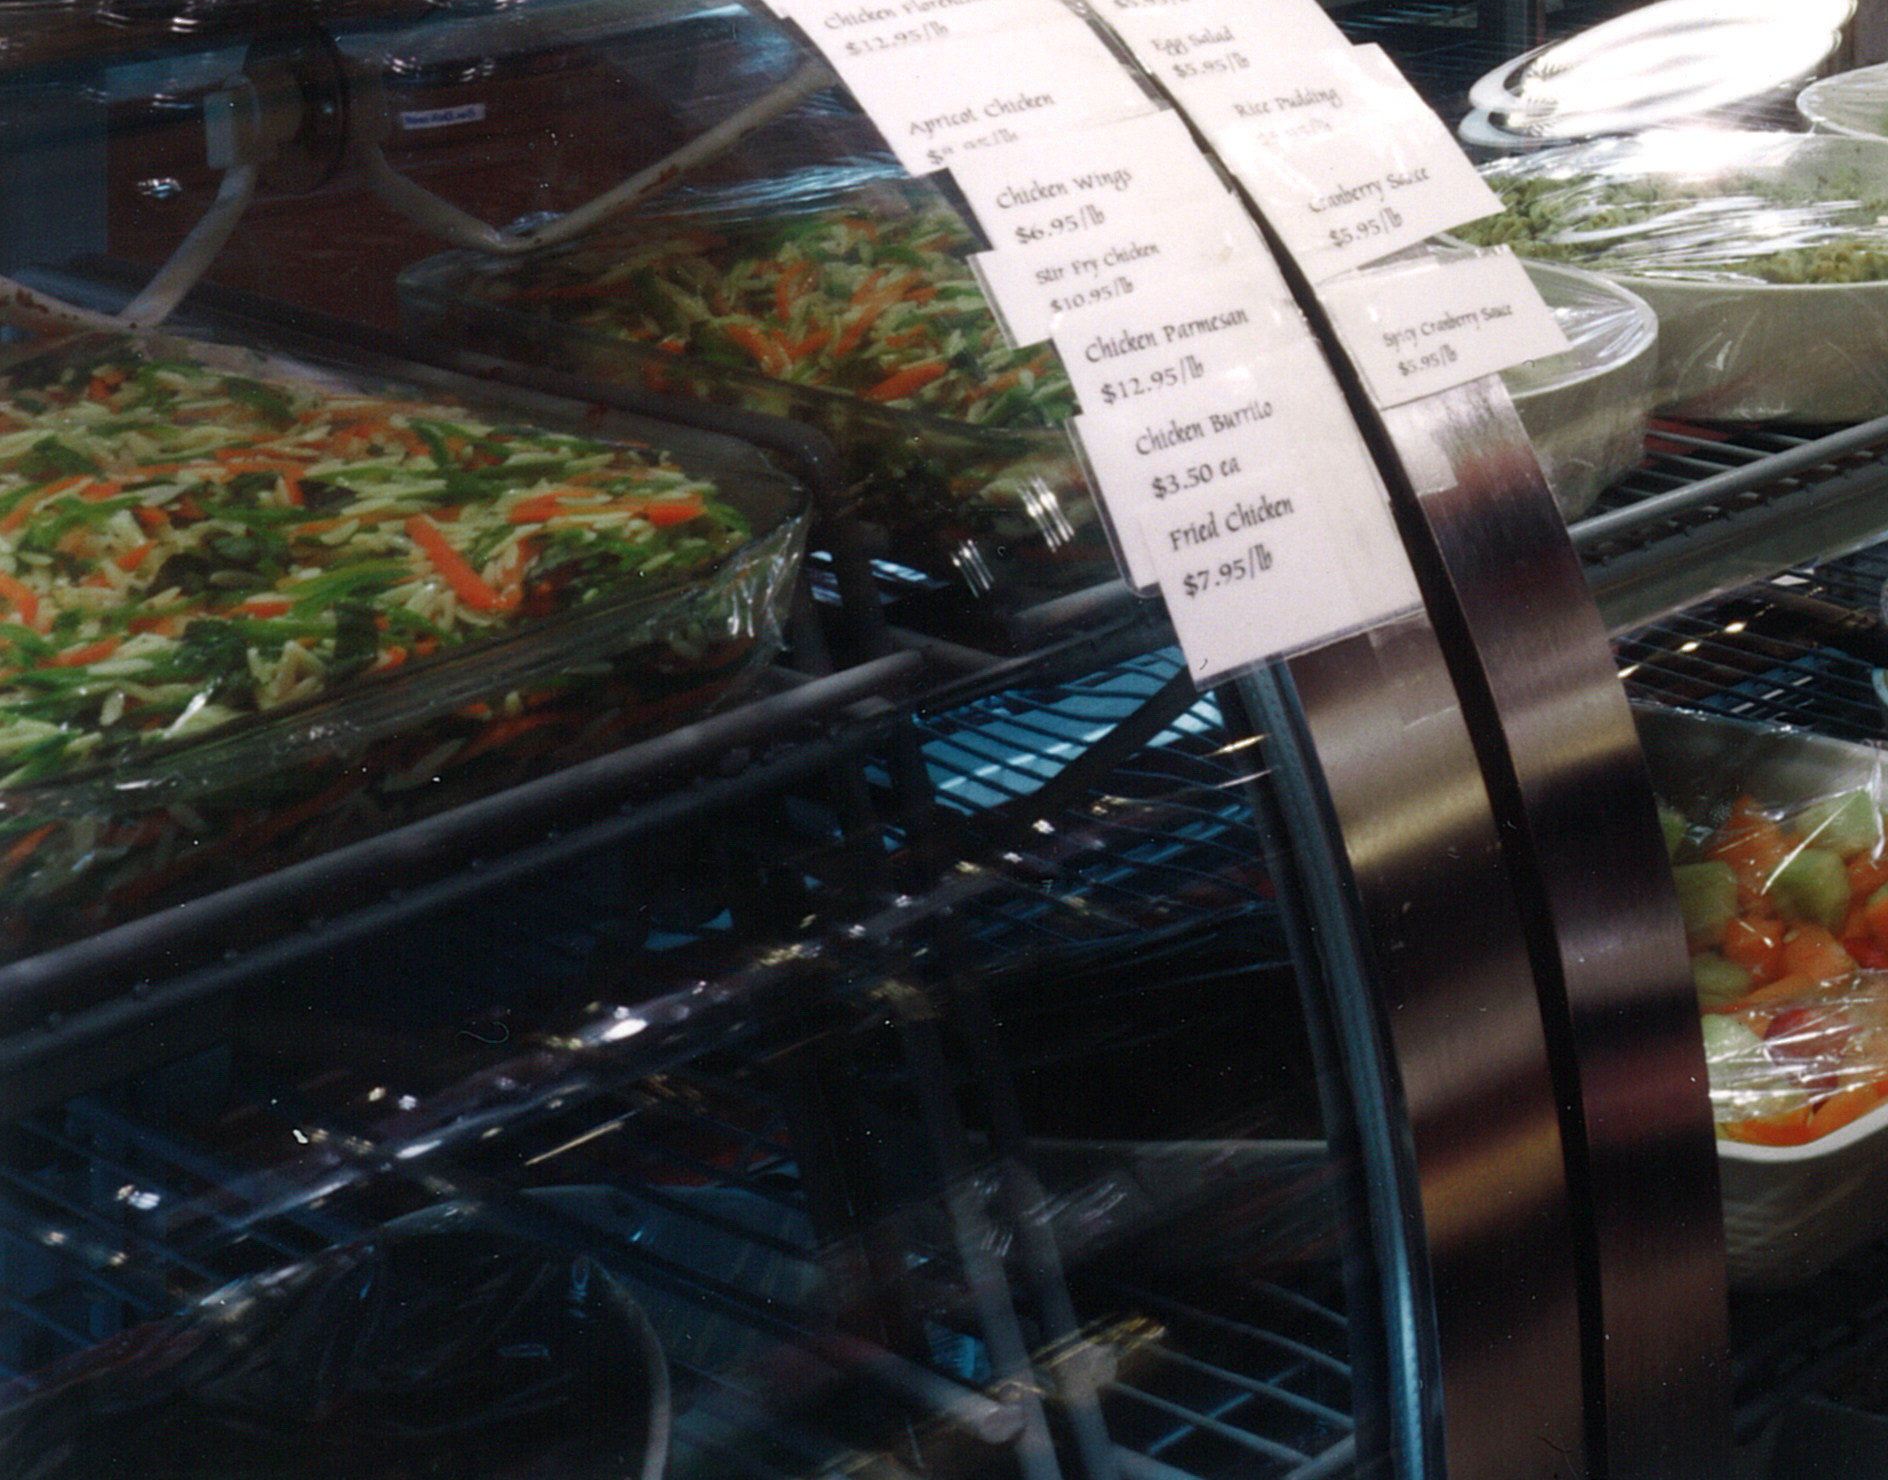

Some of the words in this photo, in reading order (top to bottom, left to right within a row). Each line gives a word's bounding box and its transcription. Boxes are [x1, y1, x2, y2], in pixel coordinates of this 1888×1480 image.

[823, 3, 897, 30] Chicken
[844, 20, 949, 56] $12.95/lb
[1150, 37, 1190, 57] Egg
[1187, 24, 1236, 46] Salad
[1172, 50, 1251, 80] $5.95/lb
[908, 106, 979, 140] Apricot
[983, 91, 1055, 119] Chicken
[1232, 99, 1272, 119] Rice
[1275, 84, 1343, 113] Pudding
[996, 180, 1069, 210] Chicken
[1073, 167, 1132, 192] Wings
[1307, 178, 1383, 214] Cranberry
[1014, 203, 1106, 245] $6.95/lb
[1327, 205, 1404, 249] $5.95/lb
[1035, 265, 1065, 286] Stir
[1071, 258, 1099, 279] Fry
[1103, 241, 1161, 268] Chicken
[1049, 275, 1134, 314] $10.95/lb
[1084, 327, 1158, 365] Chicken
[1162, 305, 1250, 344] Parmesan
[1099, 353, 1206, 405] $12.95/lb
[1397, 343, 1458, 378] $5.95/lb
[1134, 417, 1206, 457] Chicken
[1209, 399, 1274, 436] Burrito
[1150, 461, 1214, 501] $3.50
[1219, 455, 1242, 478] ea
[1168, 511, 1221, 553] Fried
[1224, 492, 1295, 534] Chicken
[1181, 542, 1274, 600] $7.95/lb
